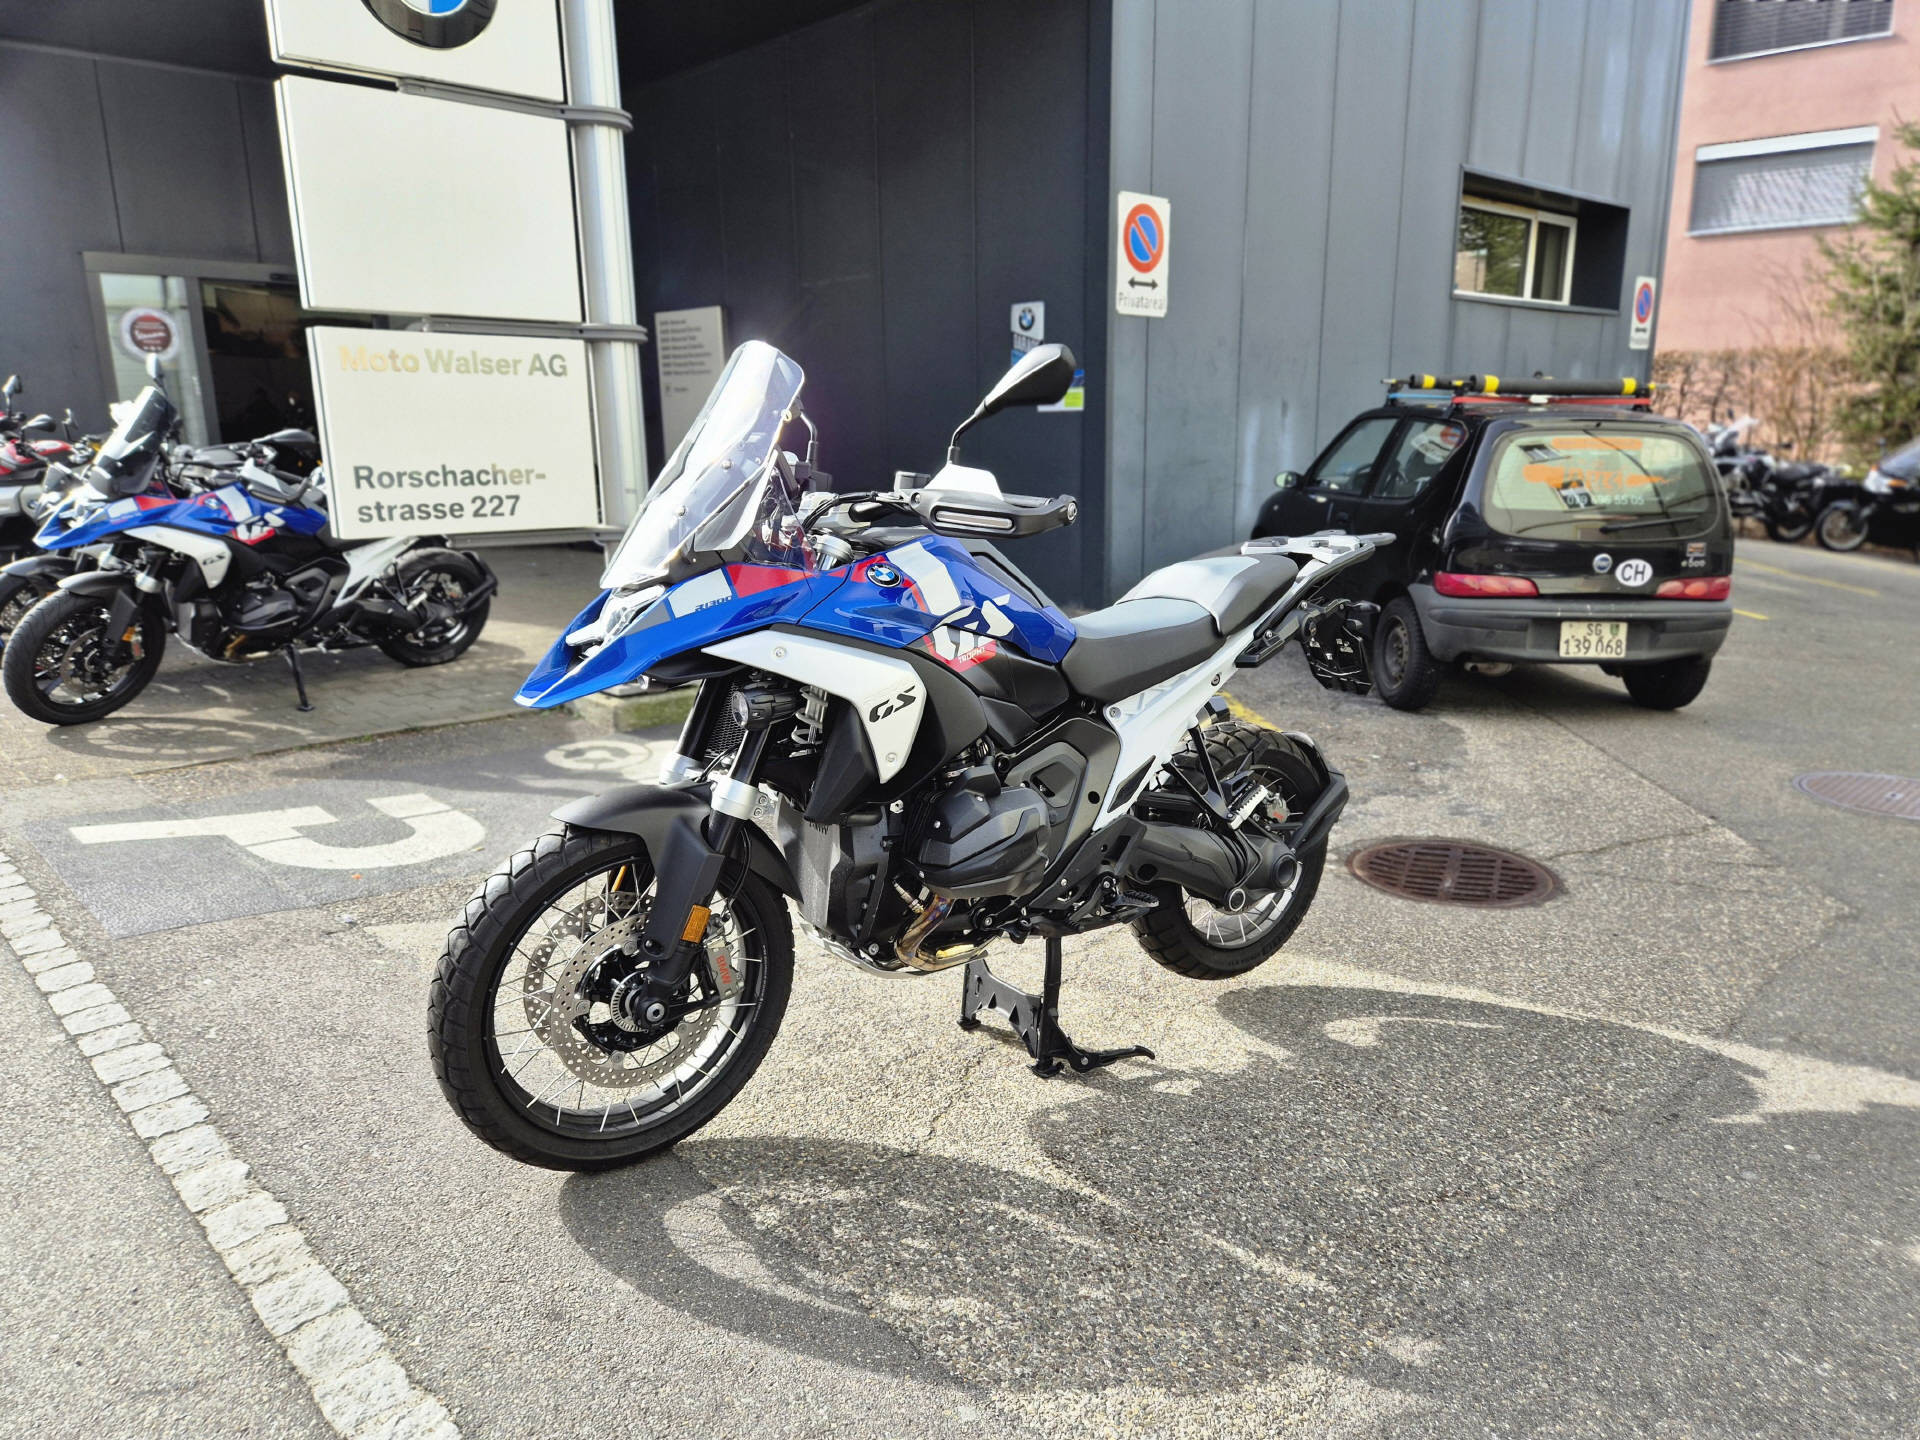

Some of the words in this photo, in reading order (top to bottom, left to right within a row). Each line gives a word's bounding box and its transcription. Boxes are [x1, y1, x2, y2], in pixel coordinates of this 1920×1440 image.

[339, 344, 420, 373] Moto
[424, 348, 523, 376] Walser
[527, 354, 569, 377] AG
[353, 464, 547, 490] Rorschacher-
[357, 500, 465, 524] strasse
[470, 495, 520, 519] 227
[1621, 563, 1646, 582] CH
[1586, 623, 1602, 636] SG
[1563, 638, 1592, 655] 139
[1595, 637, 1623, 656] 068
[869, 685, 917, 723] GS
[716, 955, 732, 985] BMW
